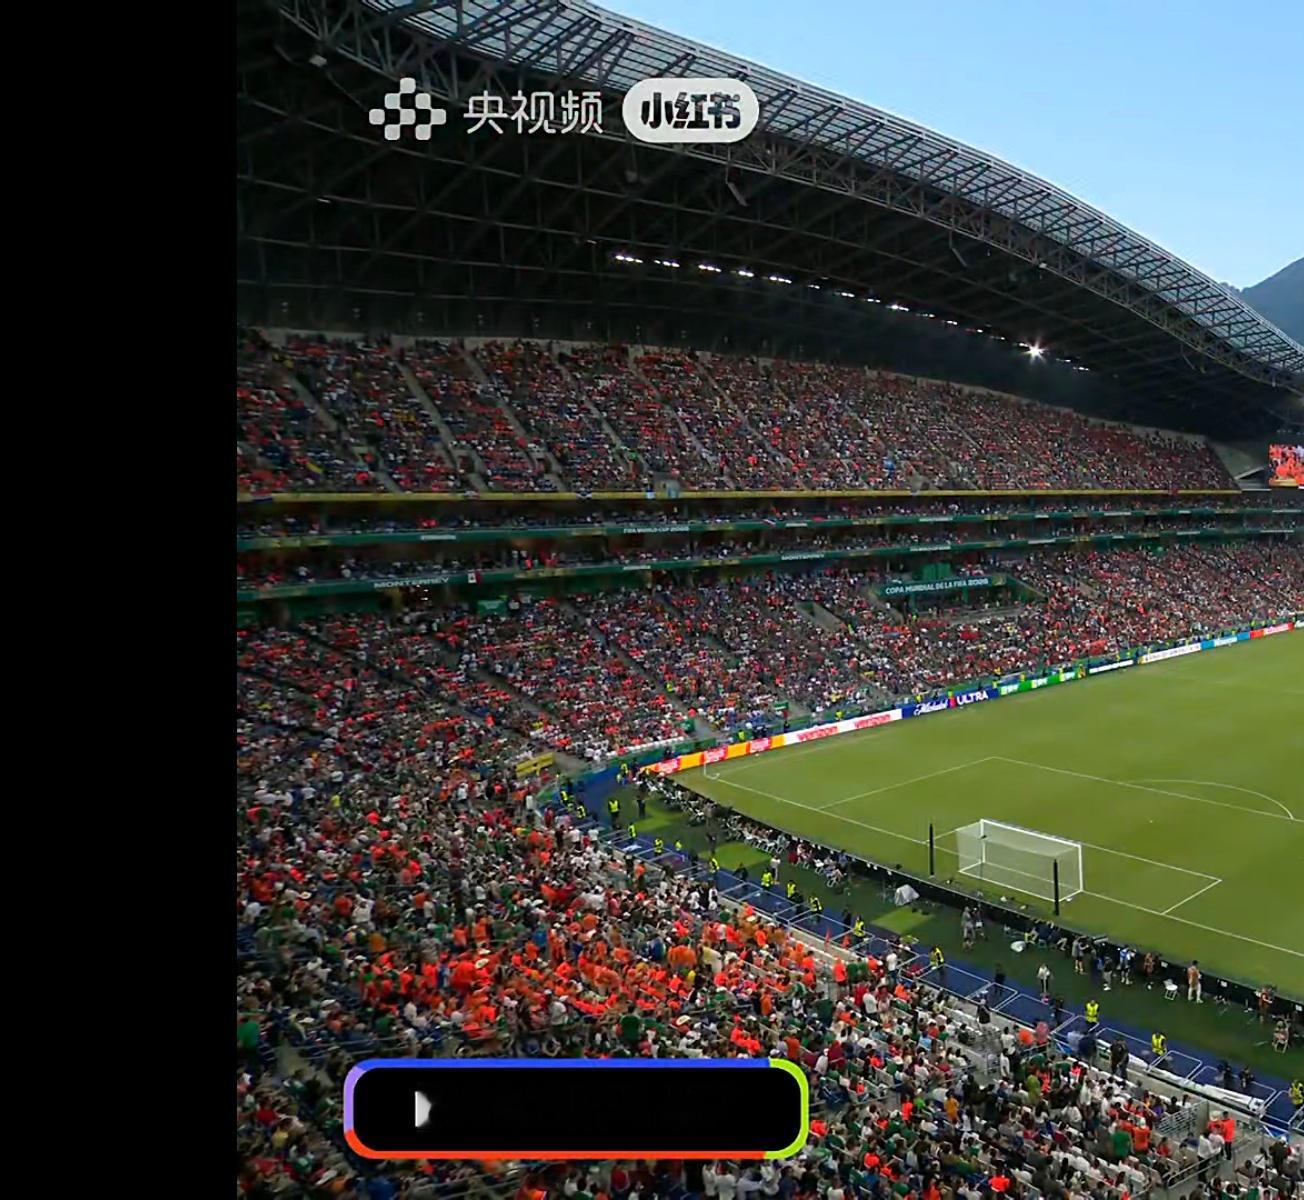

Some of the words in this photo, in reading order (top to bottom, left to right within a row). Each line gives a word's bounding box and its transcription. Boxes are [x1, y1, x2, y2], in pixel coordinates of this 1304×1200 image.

[885, 586, 904, 595] COPA
[905, 583, 935, 593] MUNDIAL
[956, 689, 989, 706] ULTRA
